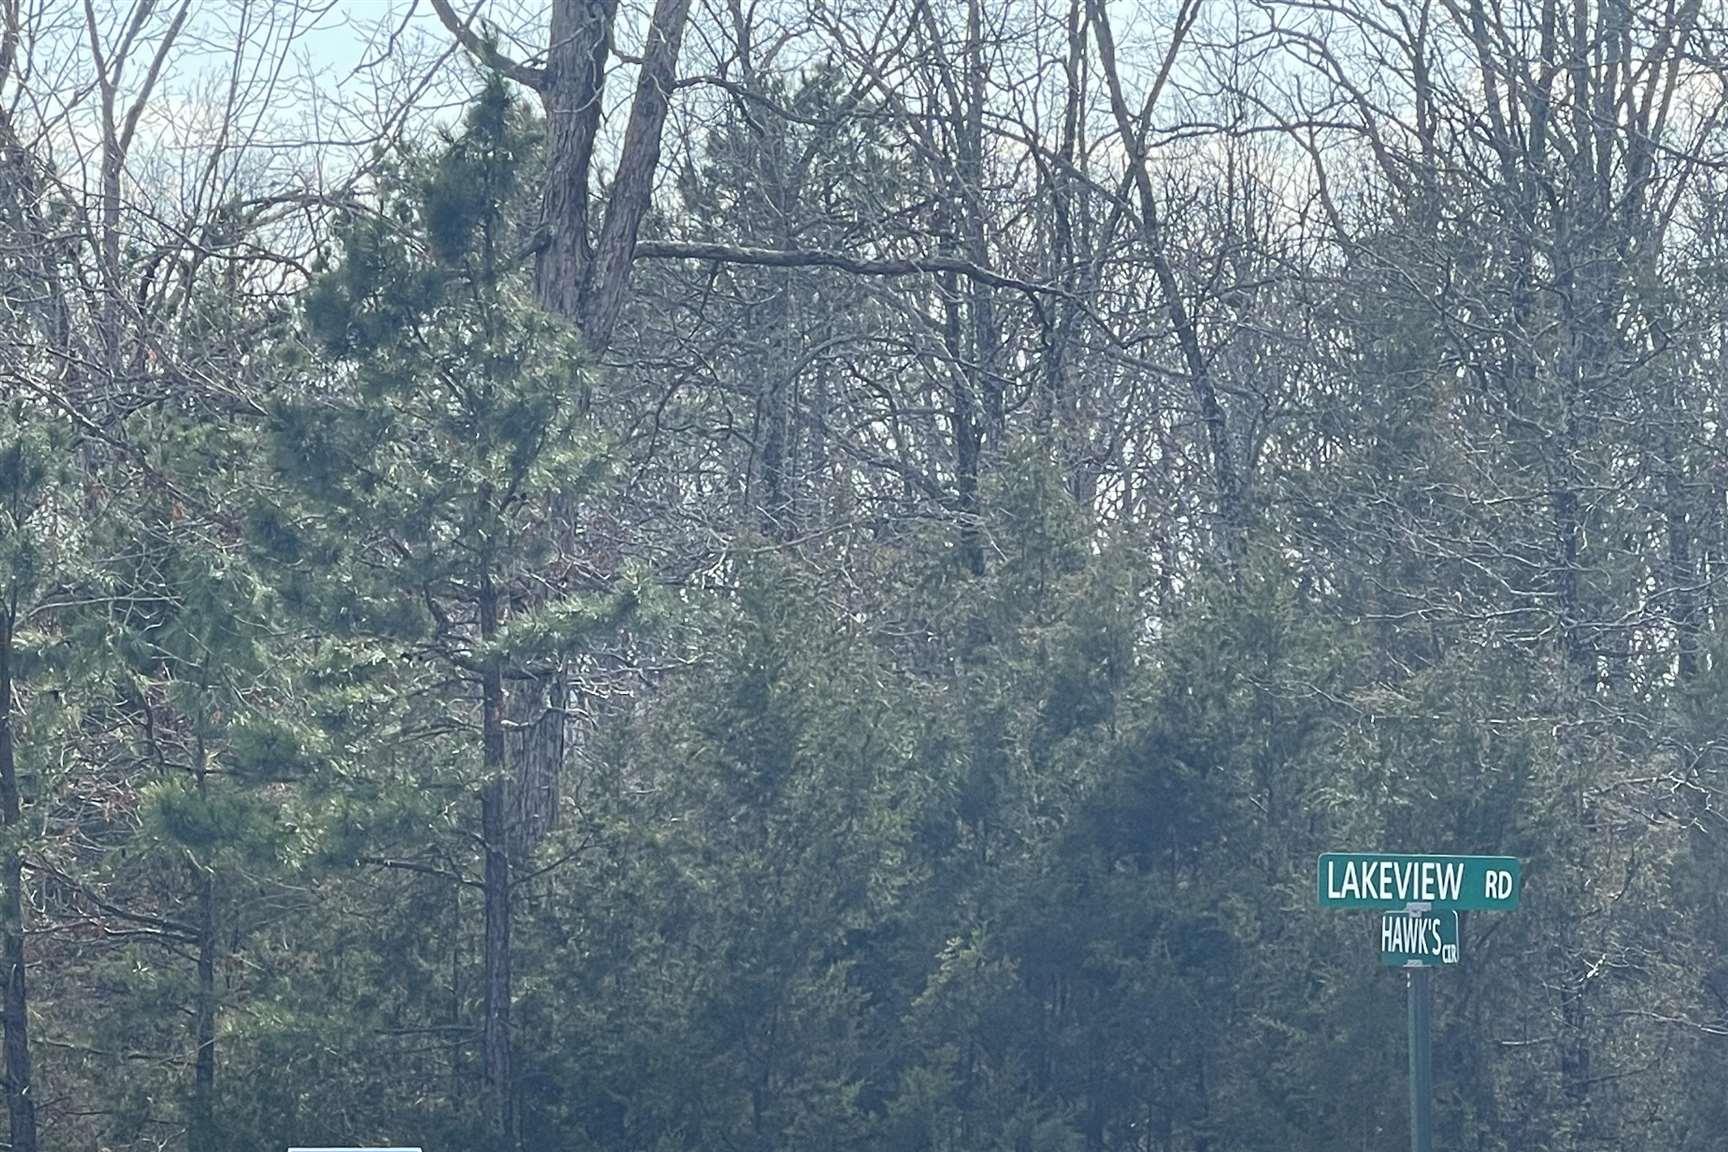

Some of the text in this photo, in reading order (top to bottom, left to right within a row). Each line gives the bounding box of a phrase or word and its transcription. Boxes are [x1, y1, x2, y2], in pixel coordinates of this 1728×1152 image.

[1328, 861, 1513, 900] LAKEVIEW RD
[1381, 916, 1457, 964] HAWK'S CIR
